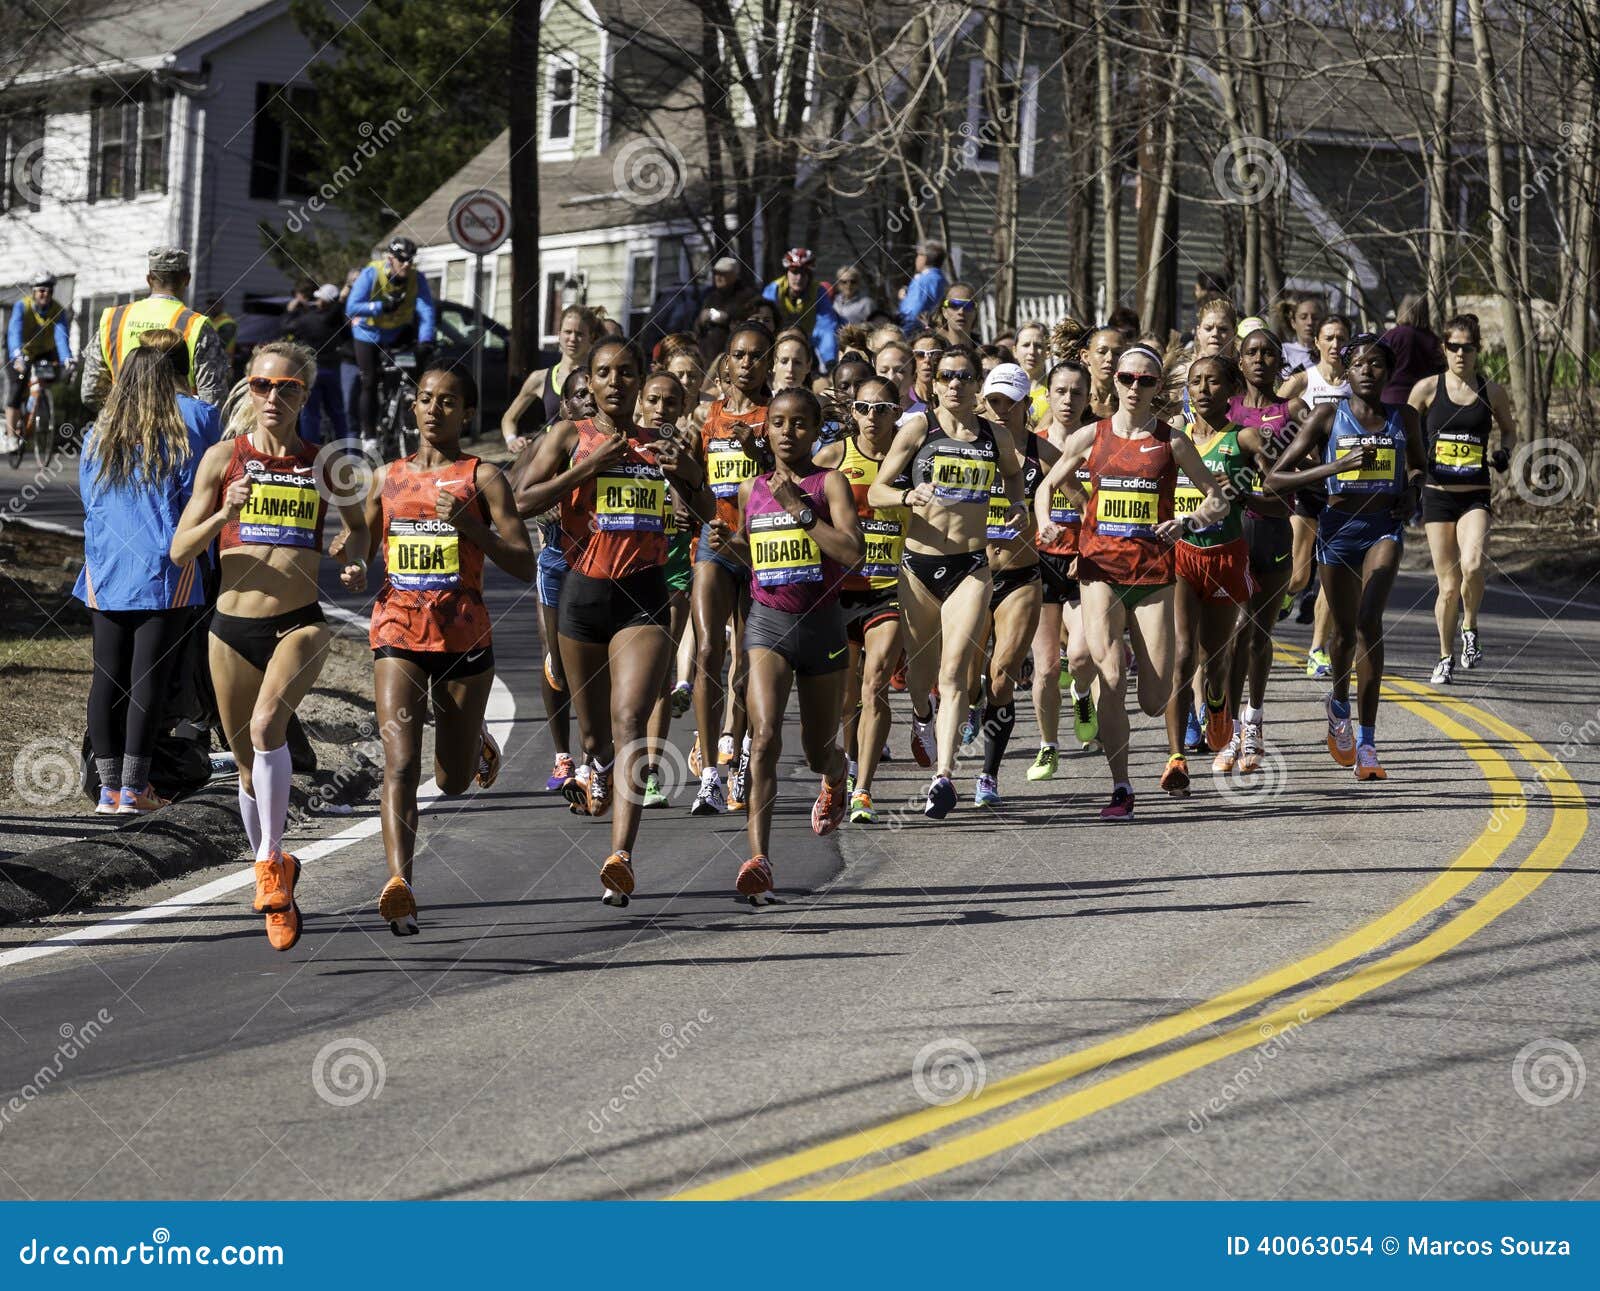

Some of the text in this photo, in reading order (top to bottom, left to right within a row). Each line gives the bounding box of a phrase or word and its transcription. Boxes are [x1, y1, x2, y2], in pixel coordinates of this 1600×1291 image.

[1451, 444, 1470, 458] 39
[939, 464, 989, 485] NELSON
[1123, 477, 1157, 489] adidas
[246, 497, 315, 520] FLANAGAN
[1104, 499, 1150, 519] DULIBA
[415, 520, 455, 532] adidas
[866, 522, 899, 532] adidas
[398, 544, 445, 570] DEBA
[756, 538, 813, 564] DIBABA
